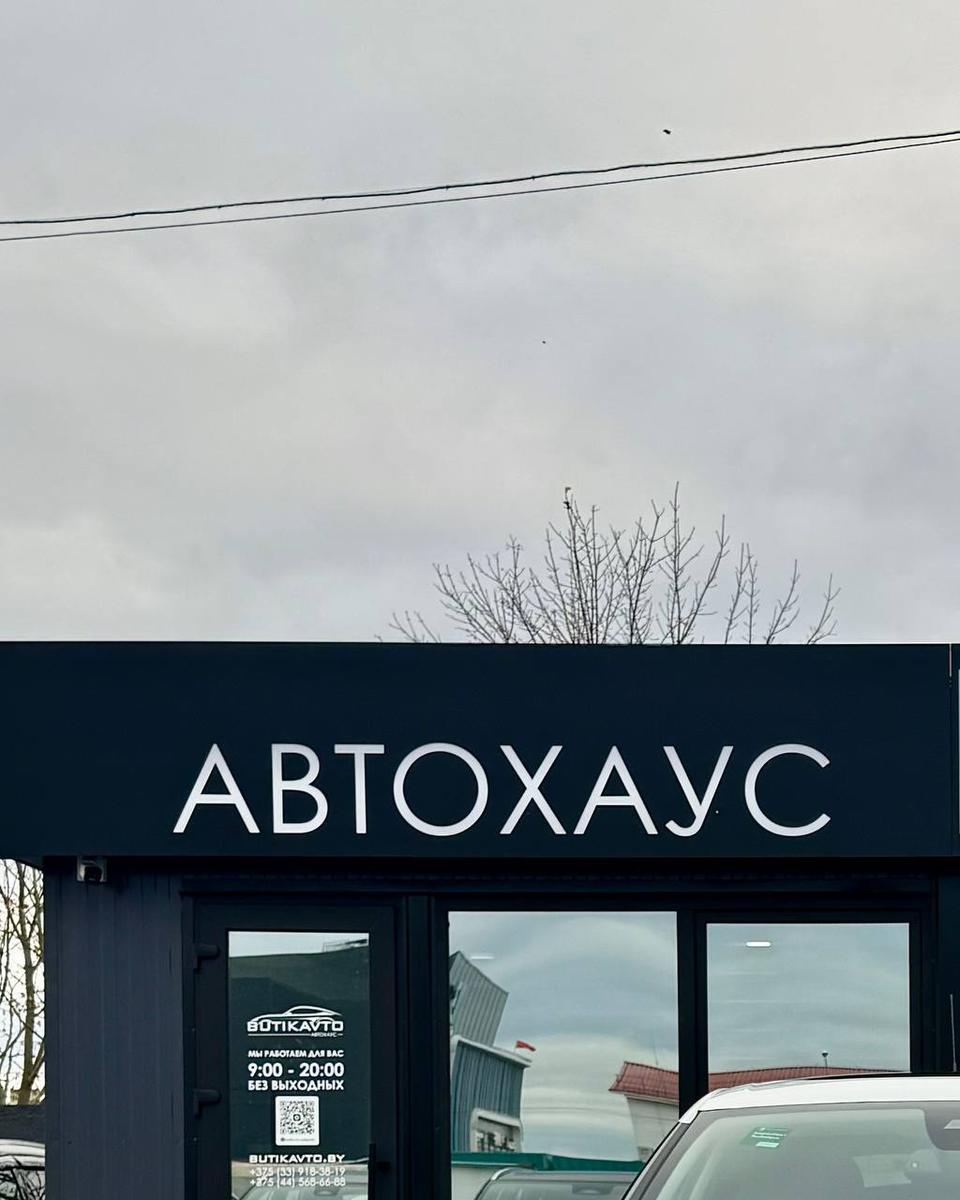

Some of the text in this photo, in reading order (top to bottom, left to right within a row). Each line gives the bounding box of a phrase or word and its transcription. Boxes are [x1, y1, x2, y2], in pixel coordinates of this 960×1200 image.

[173, 743, 831, 838] АВТОХАУС
[247, 1020, 344, 1032] BUTIKAVTO
[247, 1049, 345, 1058] МЫ РАБОТАЕМ ДЛЯ ВАС
[247, 1062, 284, 1078] 9:00
[299, 1062, 345, 1078] 20:00
[247, 1080, 345, 1092] БЕЗ ВЫХОДНЫХ
[249, 1154, 346, 1163] BUTIKAVTO.BY
